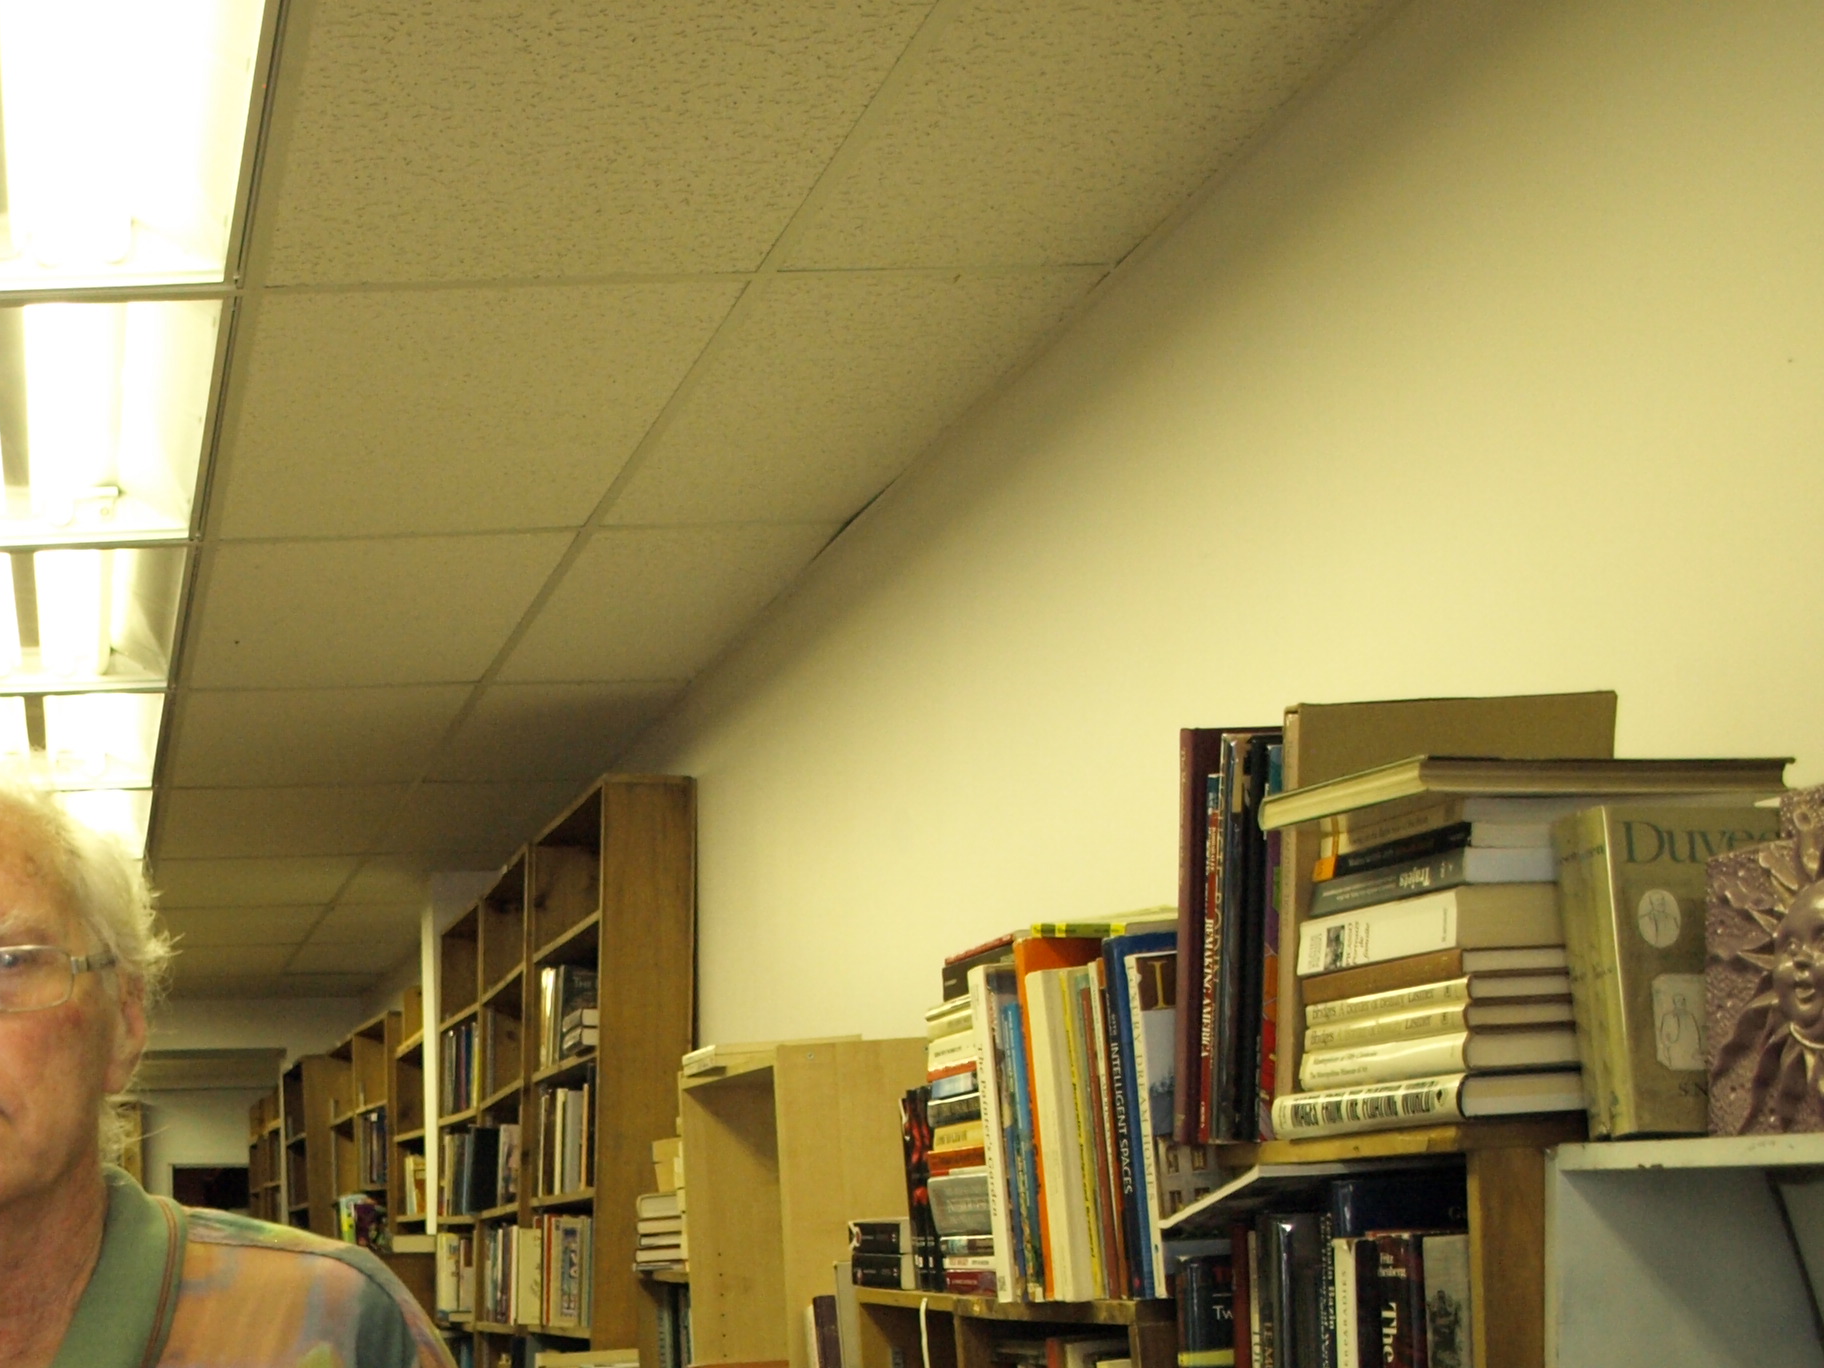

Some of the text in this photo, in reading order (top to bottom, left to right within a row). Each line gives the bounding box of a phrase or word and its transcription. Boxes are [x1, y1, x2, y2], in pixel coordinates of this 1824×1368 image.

[1200, 917, 1215, 1058] REMAKING AMERICA
[1110, 1042, 1134, 1194] INTELLIGENT SPACES
[986, 1157, 1000, 1218] Garden
[1264, 1320, 1272, 1340] LE
[1380, 1302, 1398, 1365] The
